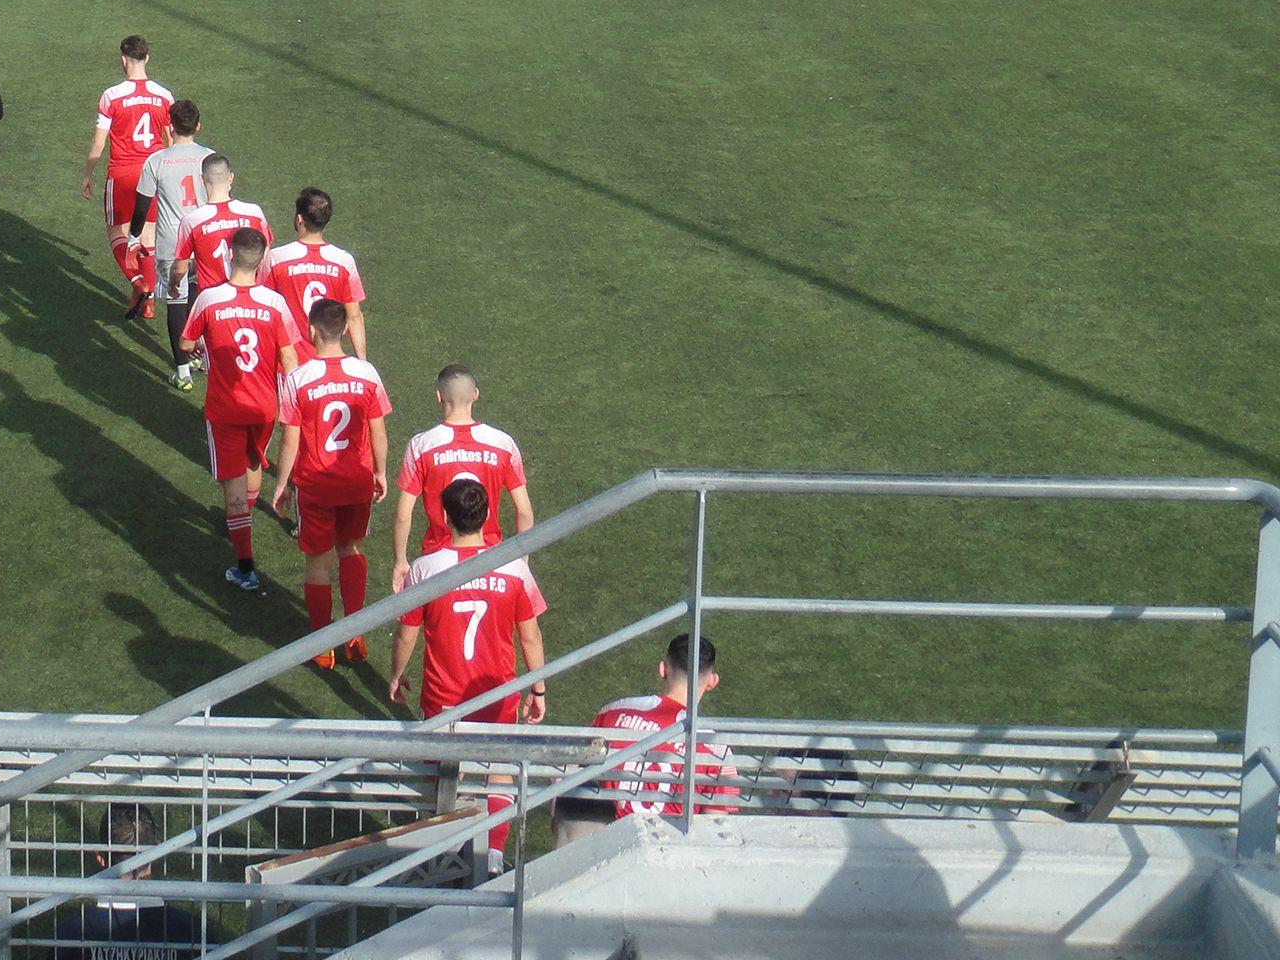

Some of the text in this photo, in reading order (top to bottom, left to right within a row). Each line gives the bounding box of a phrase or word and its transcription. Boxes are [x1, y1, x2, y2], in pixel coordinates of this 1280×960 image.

[132, 112, 155, 148] 4
[234, 327, 259, 373] 3
[322, 400, 351, 452] 2
[433, 448, 482, 466] Falirikos
[452, 600, 488, 661] 7
